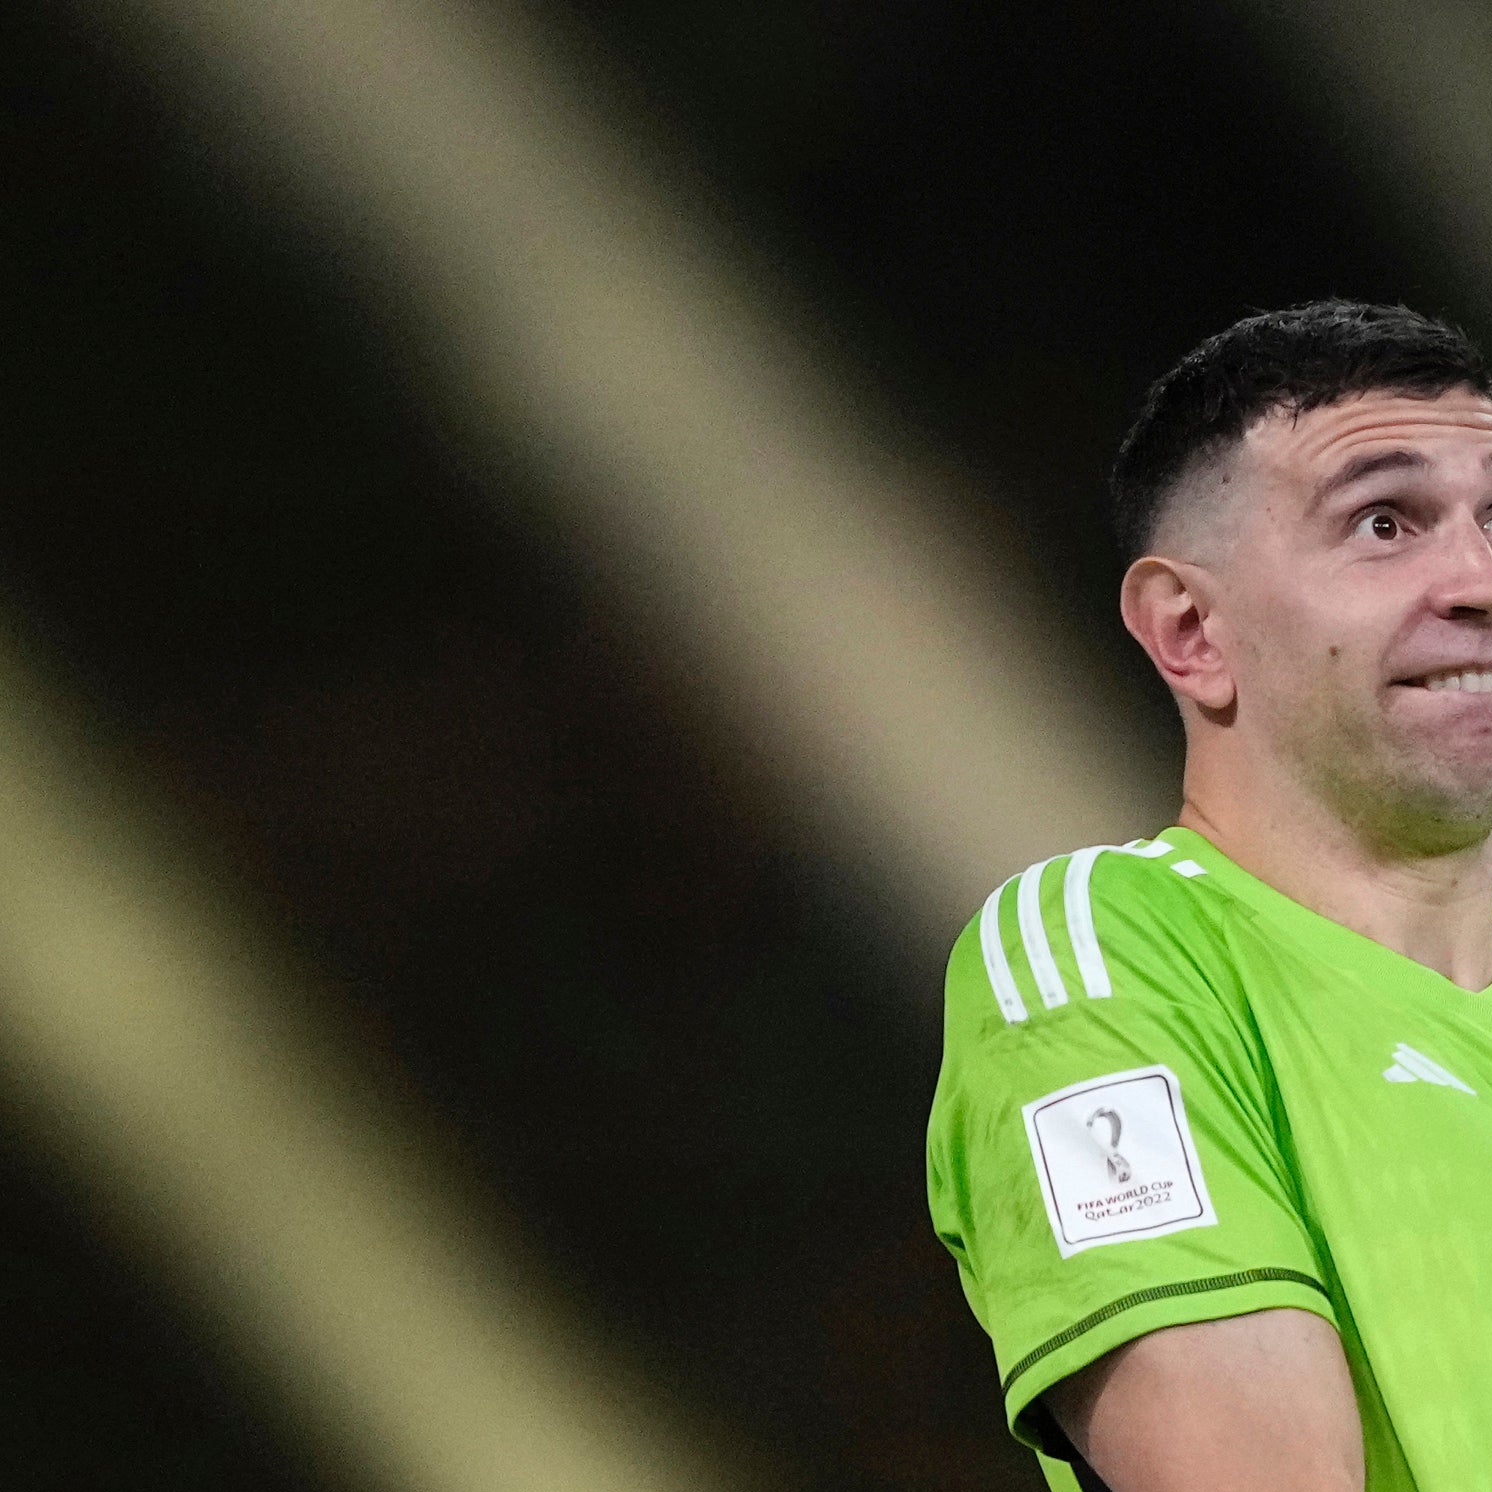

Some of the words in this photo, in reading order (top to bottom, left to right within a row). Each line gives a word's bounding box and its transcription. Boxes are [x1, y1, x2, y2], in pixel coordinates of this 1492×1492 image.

[1077, 1199, 1104, 1211] FIFA
[1105, 1185, 1149, 1204] WORLD
[1151, 1181, 1174, 1191] CUP
